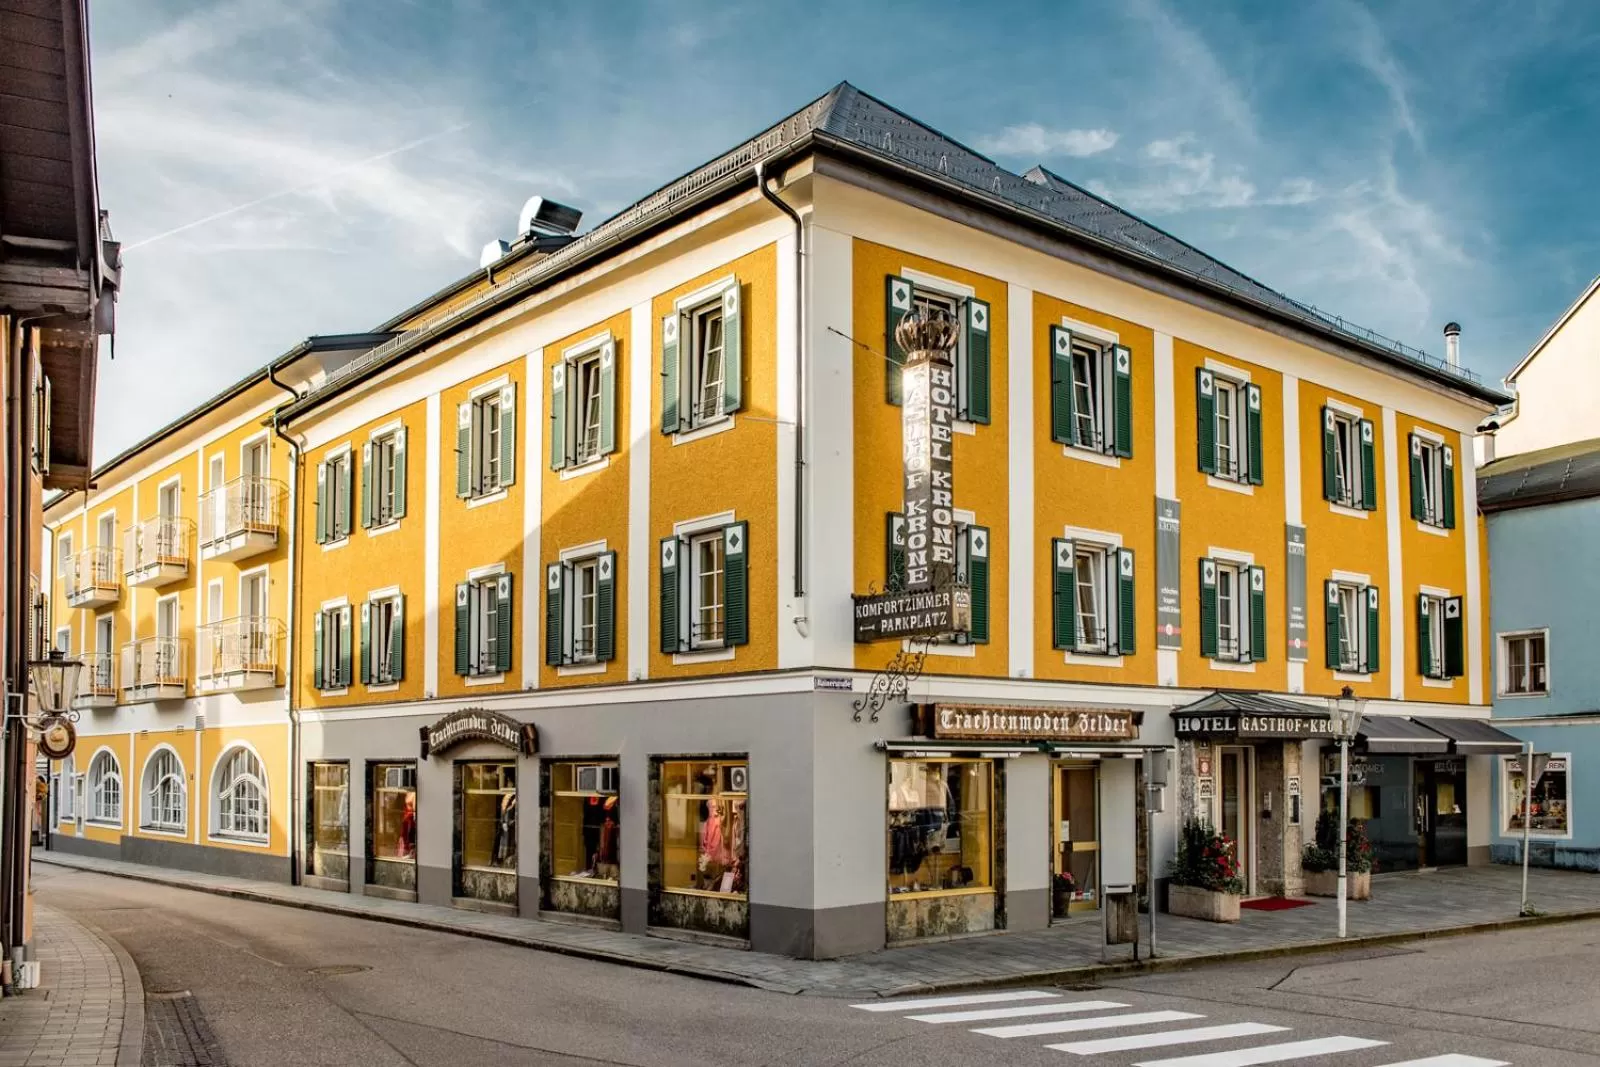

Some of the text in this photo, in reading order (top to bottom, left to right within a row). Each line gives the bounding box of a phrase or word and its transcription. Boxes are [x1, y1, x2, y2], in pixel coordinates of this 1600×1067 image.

[931, 367, 952, 564] HOTEL KRONE
[907, 498, 928, 585] KRONE
[855, 592, 950, 618] KOMFORTZIMMER
[881, 611, 947, 632] PARKPLATZ
[430, 714, 487, 747] Trachtenmoden
[941, 708, 1069, 732] Trachtenmoden
[1177, 716, 1236, 732] HOTEL
